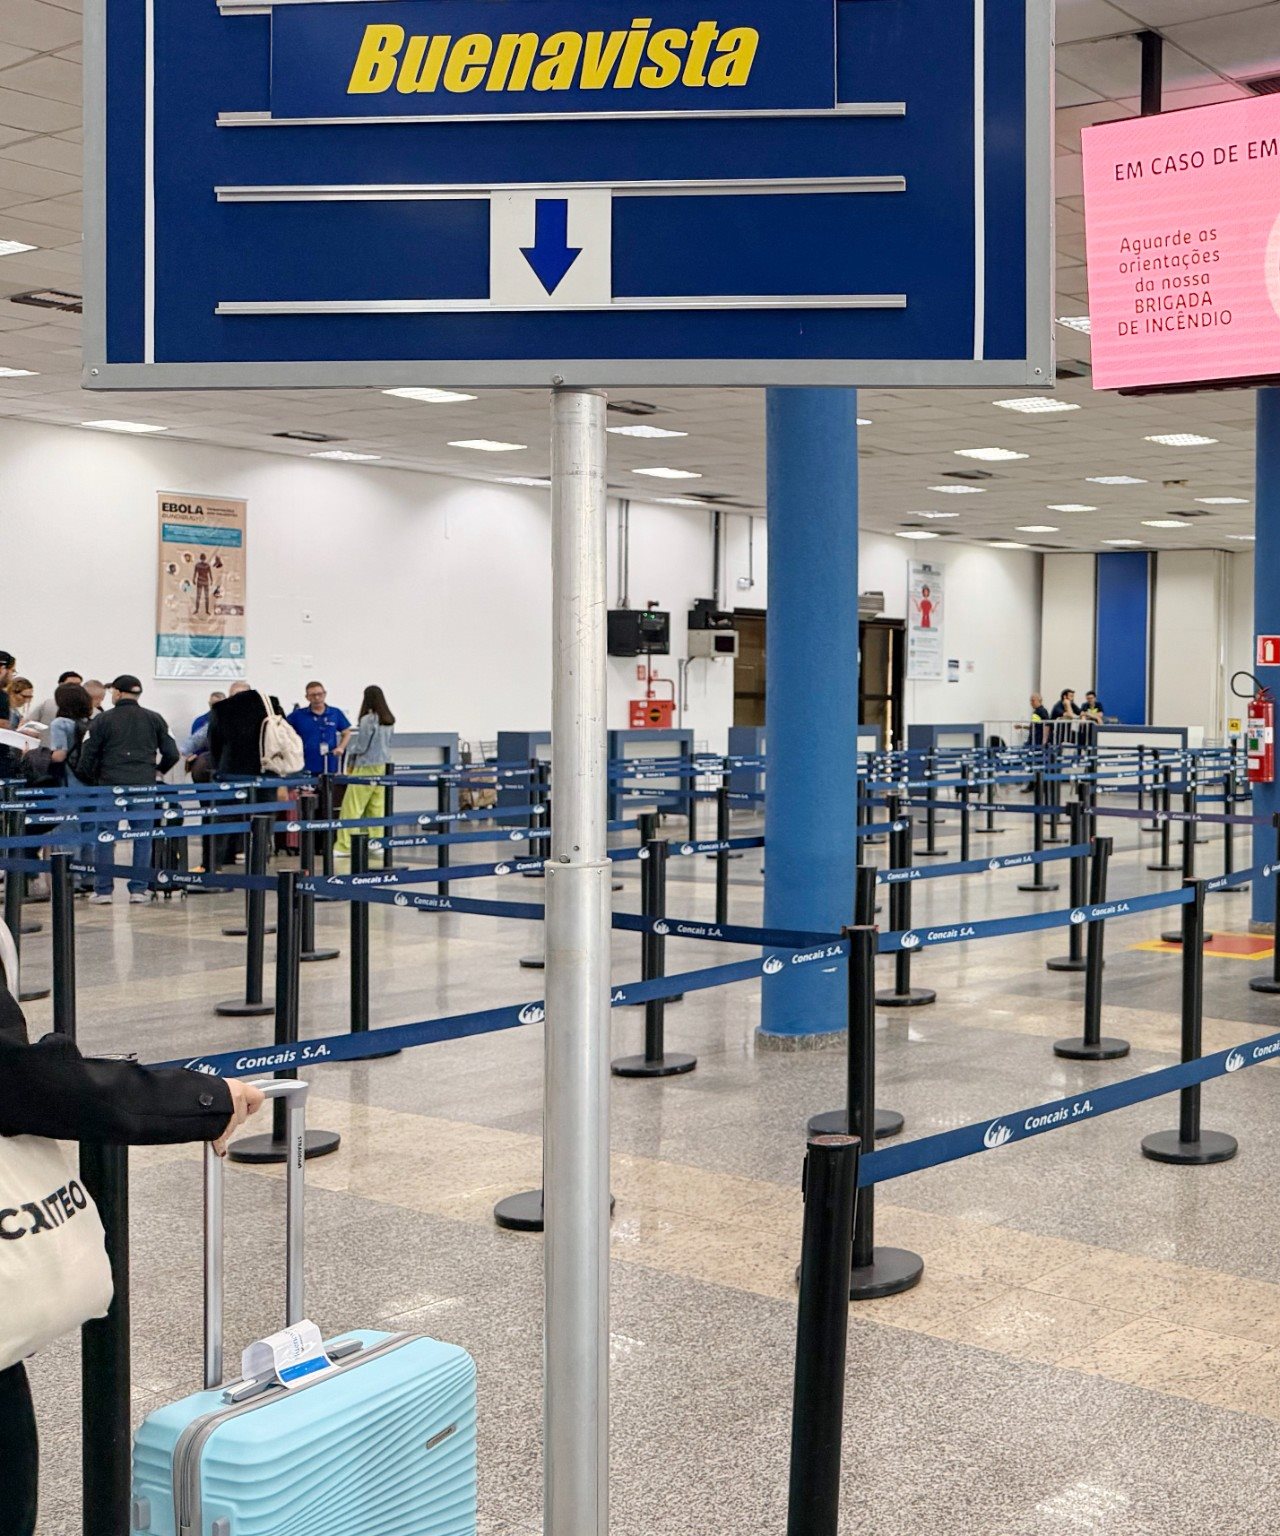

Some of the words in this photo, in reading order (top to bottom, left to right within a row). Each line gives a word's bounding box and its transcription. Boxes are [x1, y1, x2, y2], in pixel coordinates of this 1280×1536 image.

[346, 18, 760, 95] Buenavista
[1115, 161, 1144, 181] EM
[1151, 151, 1205, 176] CASO
[1213, 144, 1239, 166] DE
[1119, 229, 1193, 258] Aguarde
[1198, 227, 1217, 245] as
[1118, 245, 1221, 274] orientações
[1134, 274, 1155, 291] da
[1161, 270, 1210, 290] nossa
[1134, 290, 1213, 314] BRIGADA
[1117, 320, 1140, 336] DE
[1145, 308, 1232, 334] INCÊNDIO
[162, 502, 204, 515] EBOLA
[122, 831, 150, 839] Concais
[516, 862, 542, 870] Concais
[352, 875, 382, 885] Concais
[382, 874, 398, 883] S.A.
[887, 872, 908, 880] Concais
[414, 897, 438, 906] Concais
[1092, 906, 1116, 917] Concais
[1117, 903, 1130, 913] S.A.
[677, 925, 706, 935] Concais
[707, 927, 723, 937] S.A.
[928, 929, 958, 941] Concais
[960, 927, 975, 937] S.A.
[792, 950, 825, 964] Concais
[826, 946, 843, 957] S.A.
[611, 990, 626, 1002] .A.
[236, 1051, 296, 1070] Concais
[301, 1044, 331, 1059] S.A.
[1024, 1106, 1069, 1131] Concais
[1072, 1100, 1094, 1117] S.A.
